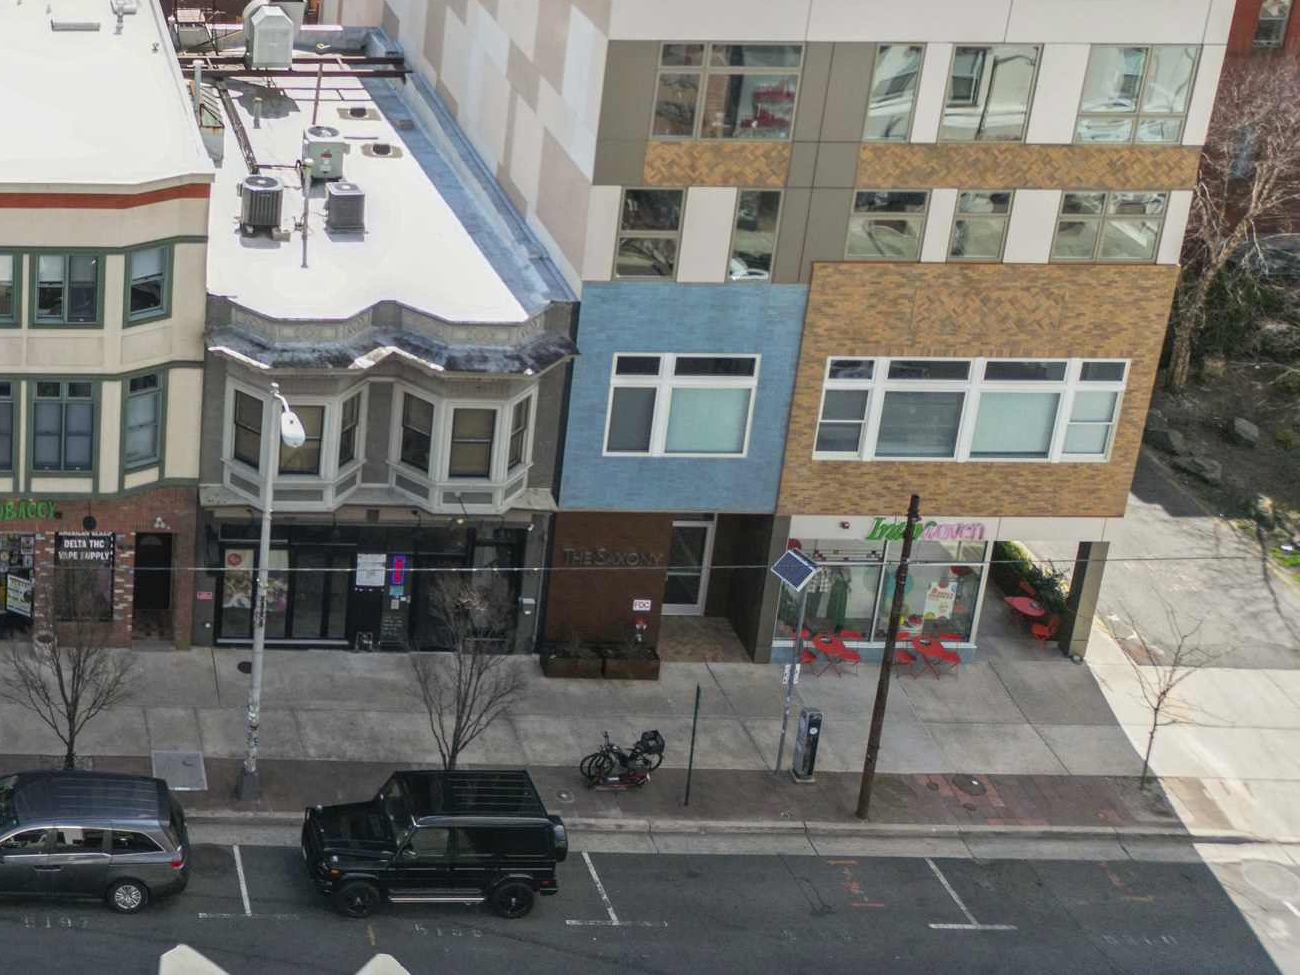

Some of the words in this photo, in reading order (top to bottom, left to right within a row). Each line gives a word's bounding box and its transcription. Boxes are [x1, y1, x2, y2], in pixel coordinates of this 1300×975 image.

[64, 539, 87, 548] DELTA
[89, 539, 105, 548] THC
[58, 551, 78, 560] VAPE
[80, 551, 110, 560] SUPPLY
[563, 548, 592, 565] THE
[595, 548, 662, 566] SAXONY
[634, 601, 650, 609] FDC
